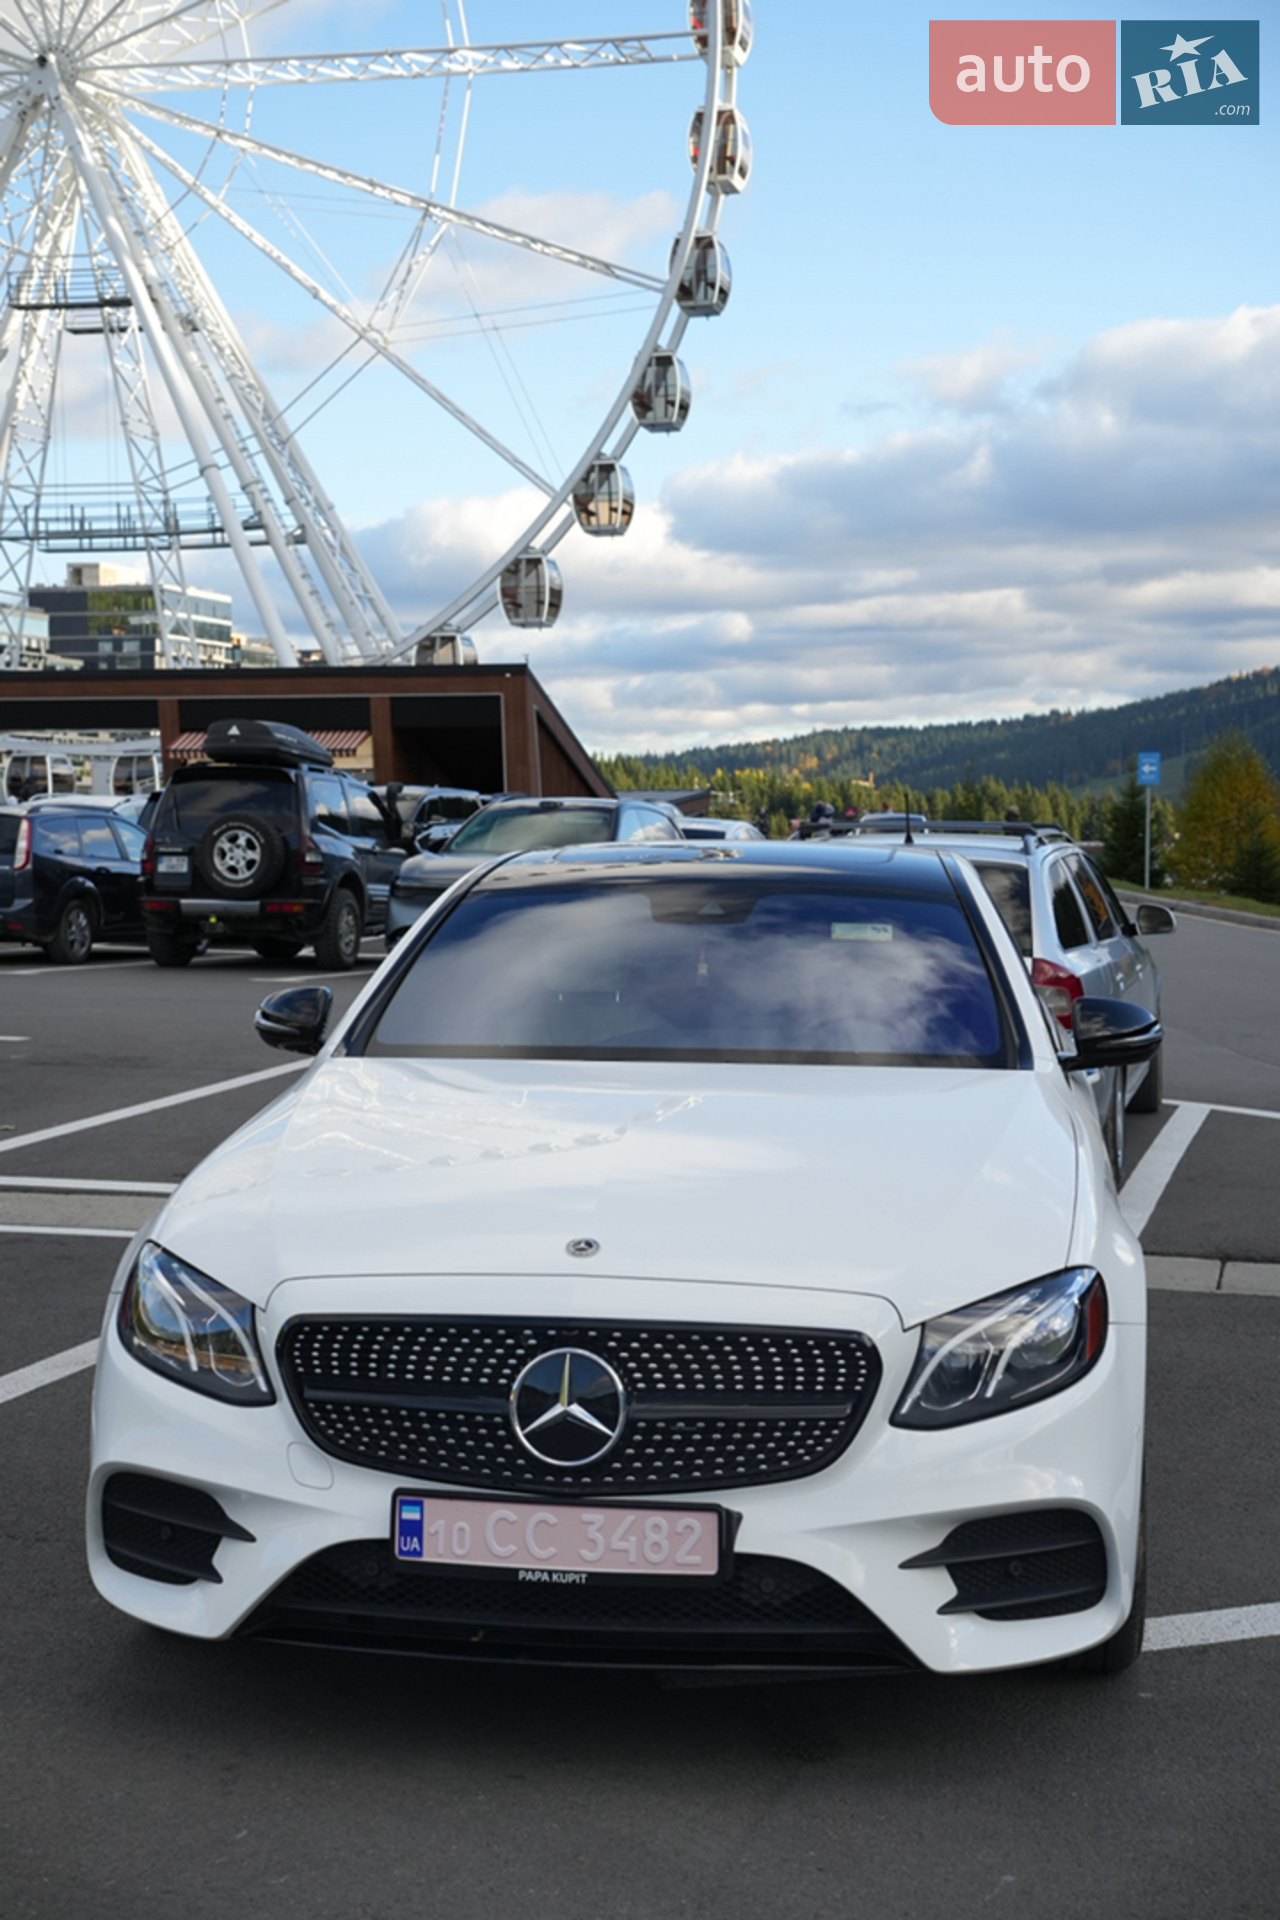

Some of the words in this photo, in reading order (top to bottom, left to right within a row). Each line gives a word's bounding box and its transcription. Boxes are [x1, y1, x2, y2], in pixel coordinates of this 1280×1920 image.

[400, 1536, 421, 1552] UA
[428, 1519, 471, 1556] 10
[485, 1509, 558, 1560] CC
[578, 1513, 702, 1566] 3482
[518, 1569, 550, 1582] PAPA
[552, 1572, 588, 1584] KUPIT
